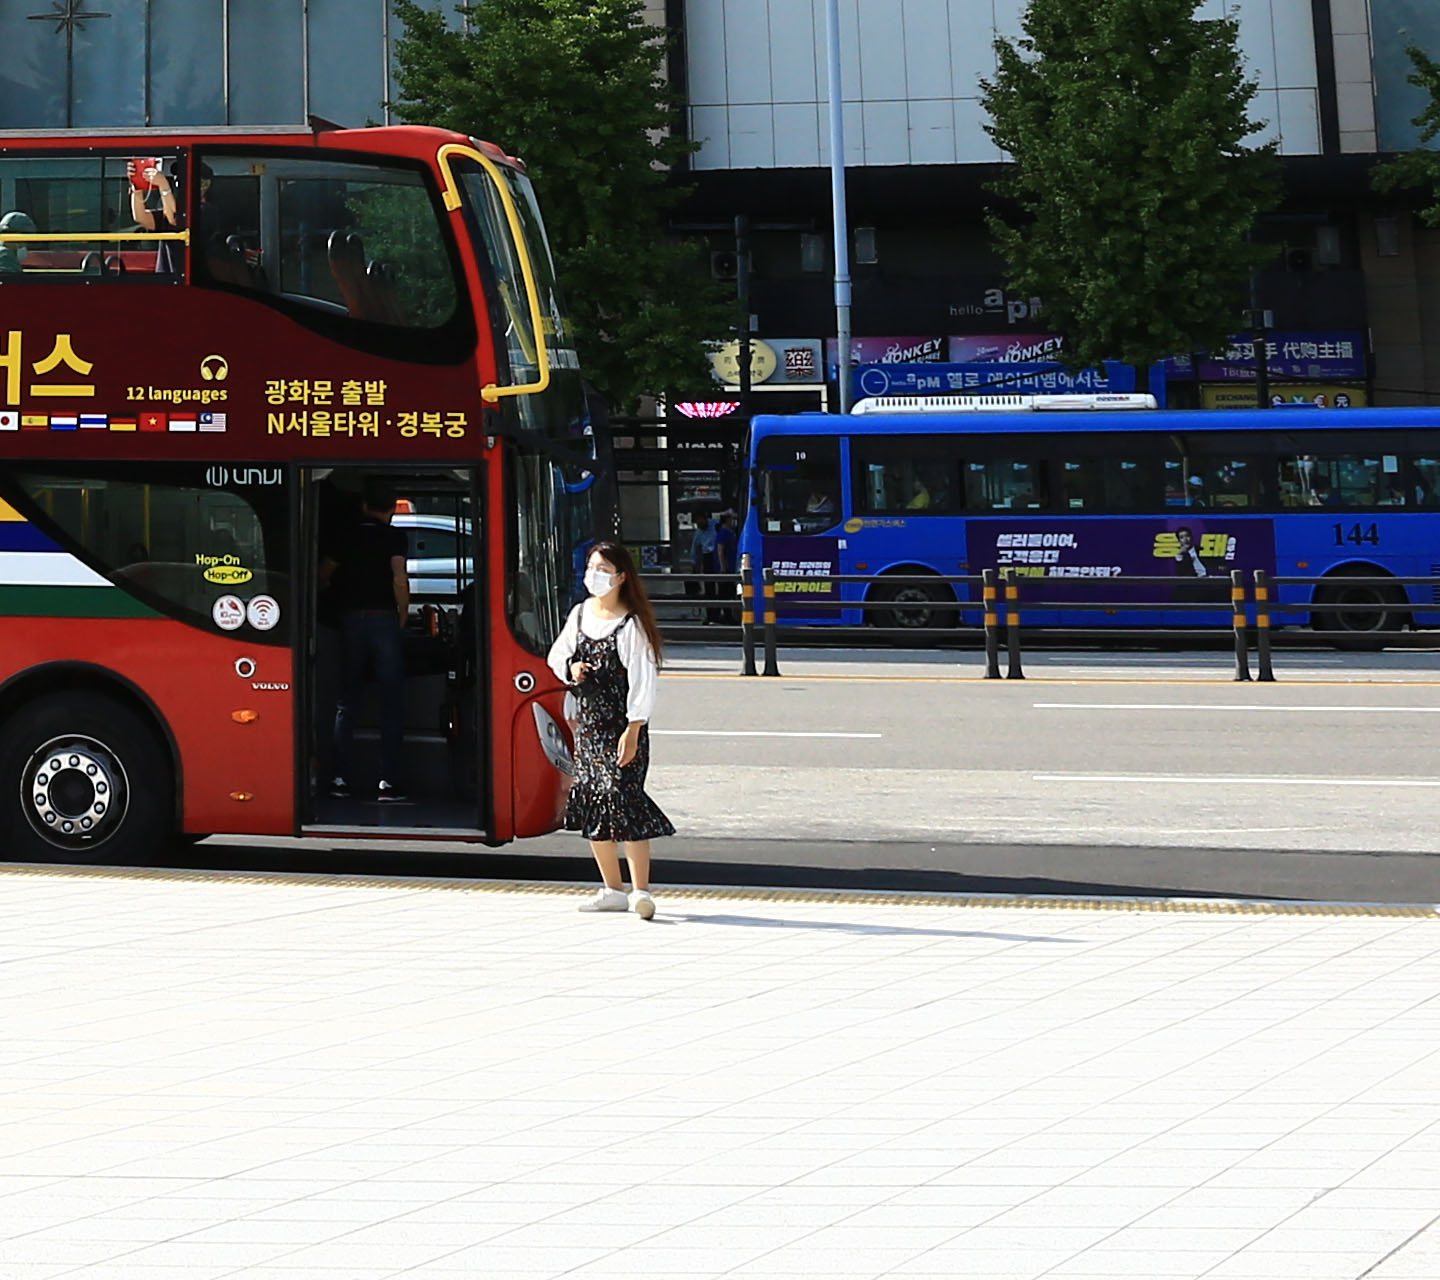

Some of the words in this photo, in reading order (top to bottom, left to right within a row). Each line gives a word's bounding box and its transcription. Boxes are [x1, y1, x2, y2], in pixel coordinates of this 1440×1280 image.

[949, 304, 984, 316] hello
[946, 372, 981, 389] 헬로
[126, 387, 145, 401] 12
[148, 385, 228, 404] languages
[264, 379, 335, 406] 광화문
[339, 379, 388, 406] 출발
[267, 411, 381, 438] N서울타워
[395, 411, 468, 438] 경복궁
[996, 533, 1078, 549] 셀러들이여,
[1332, 522, 1380, 546] 144
[195, 552, 240, 567] Hop-On
[207, 569, 249, 582] Hop-Off
[251, 682, 289, 690] VOLVO
